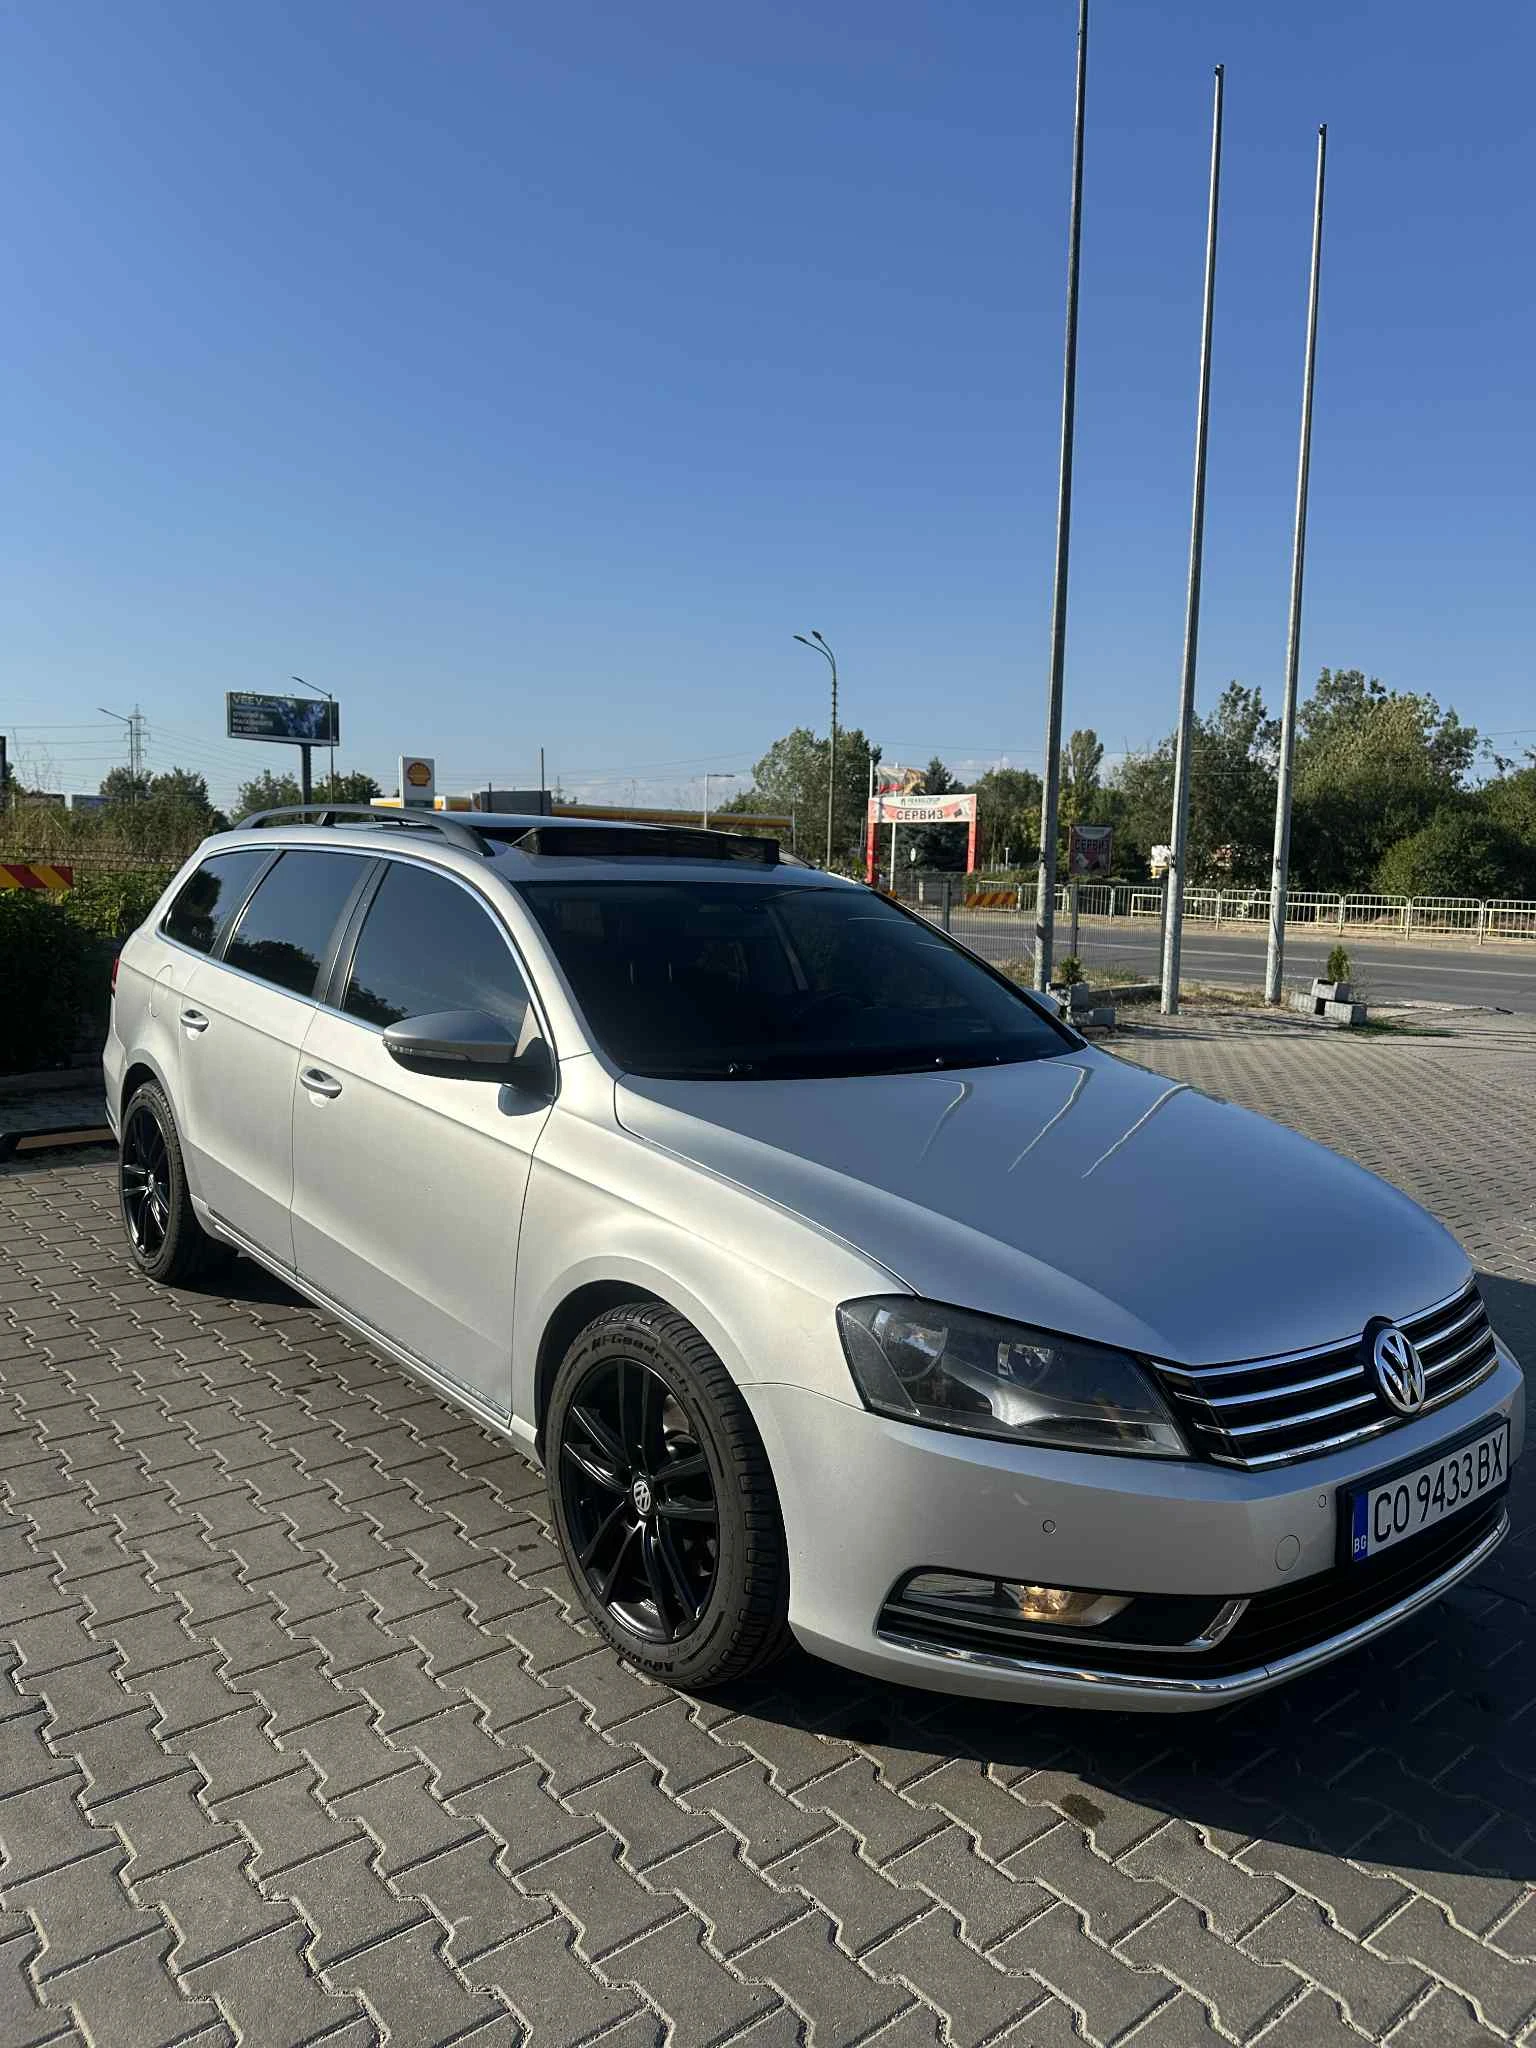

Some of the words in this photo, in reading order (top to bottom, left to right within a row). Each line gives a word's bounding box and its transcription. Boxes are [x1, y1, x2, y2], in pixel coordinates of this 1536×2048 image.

[896, 809, 944, 820] СЕРВИЗ
[1376, 1331, 1423, 1410] VW
[1374, 1485, 1410, 1543] CO
[1416, 1452, 1473, 1523] 9433
[1477, 1432, 1504, 1491] BX
[1353, 1535, 1368, 1553] BG
